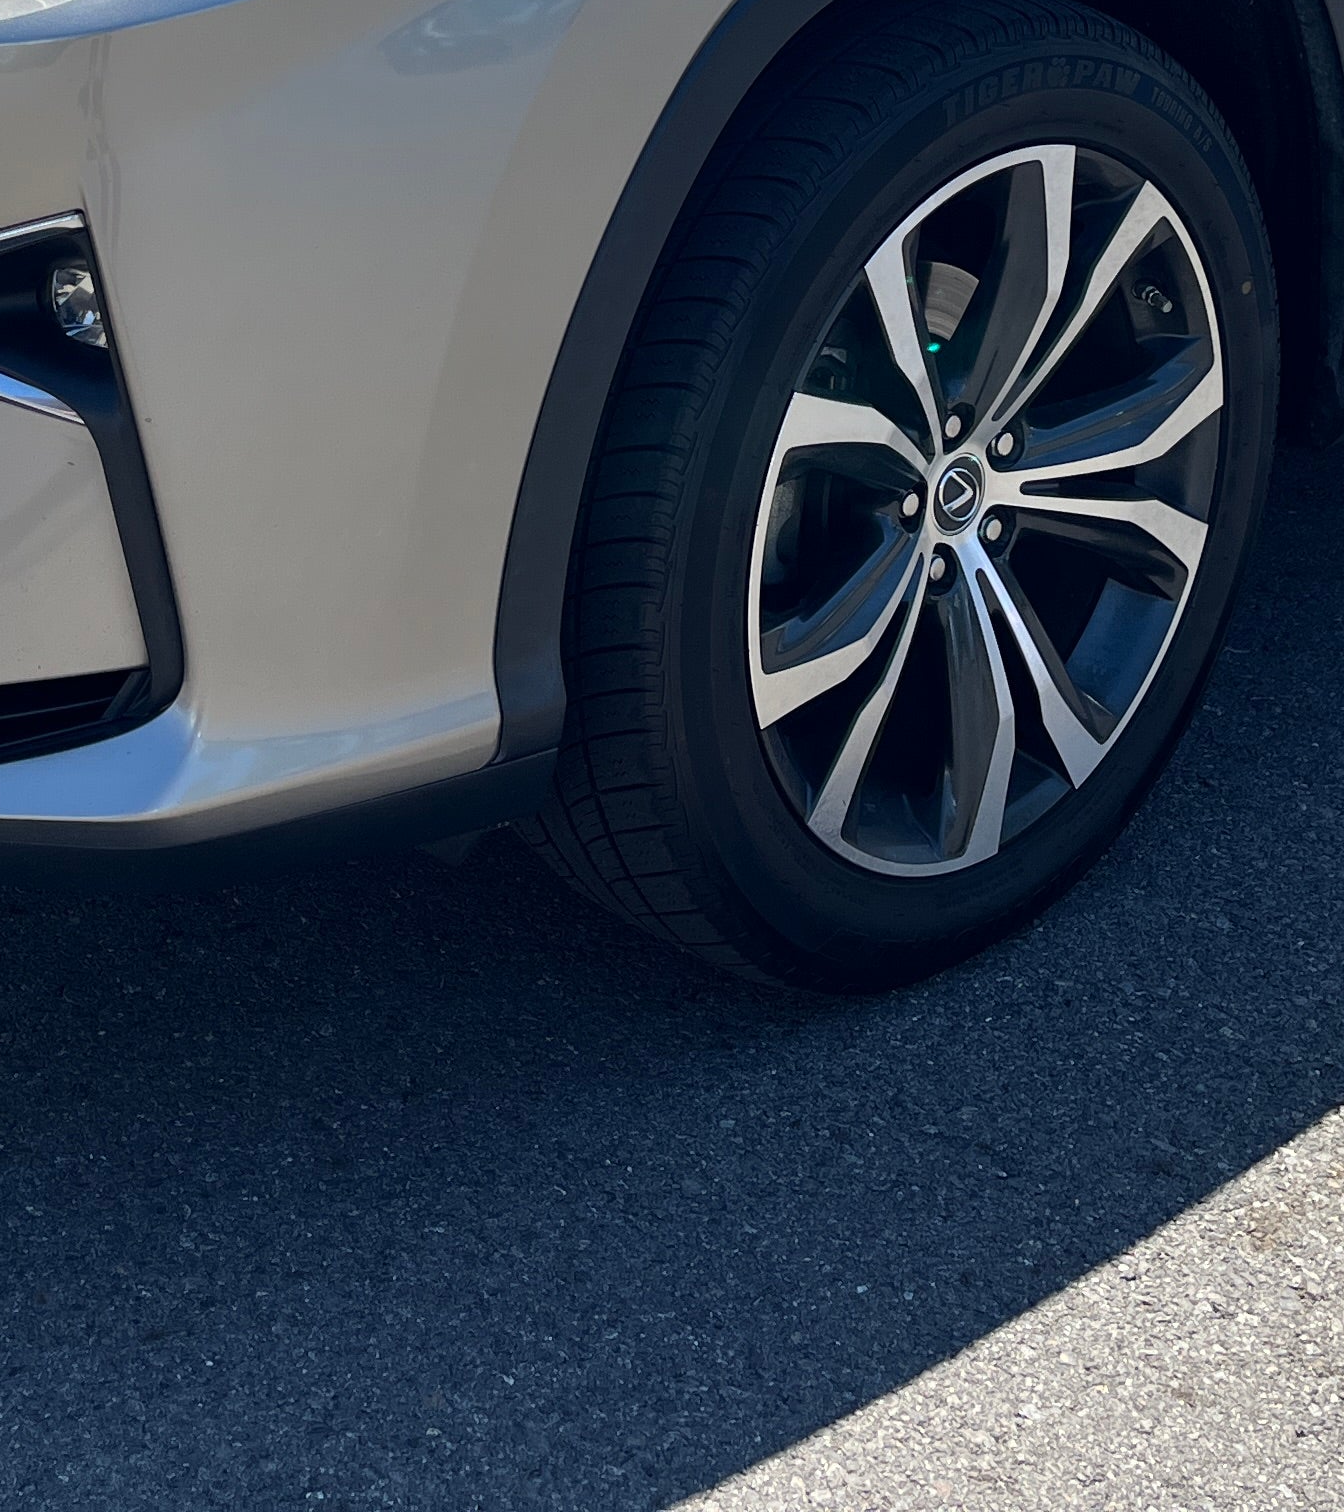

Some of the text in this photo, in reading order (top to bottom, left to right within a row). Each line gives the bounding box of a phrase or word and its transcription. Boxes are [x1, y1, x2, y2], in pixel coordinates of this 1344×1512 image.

[942, 58, 1142, 128] TIGER PAW
[1151, 85, 1213, 152] TOURING A/S
